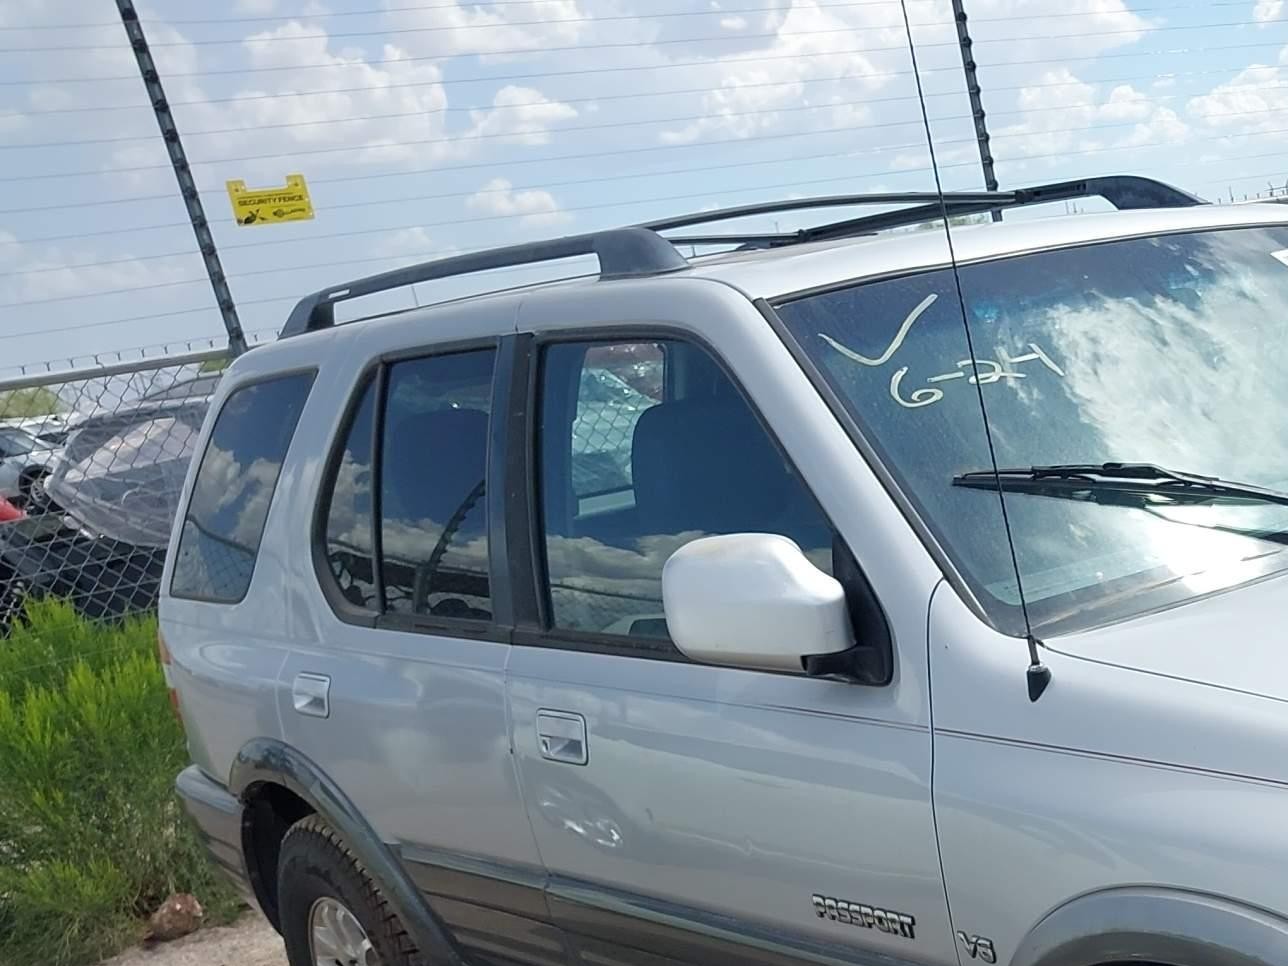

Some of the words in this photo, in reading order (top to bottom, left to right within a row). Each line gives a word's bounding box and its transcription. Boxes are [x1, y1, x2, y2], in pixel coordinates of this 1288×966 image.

[238, 196, 277, 207] SECURITY
[278, 194, 304, 203] FENCE
[812, 893, 916, 939] PASSPORT
[956, 929, 998, 965] V6
